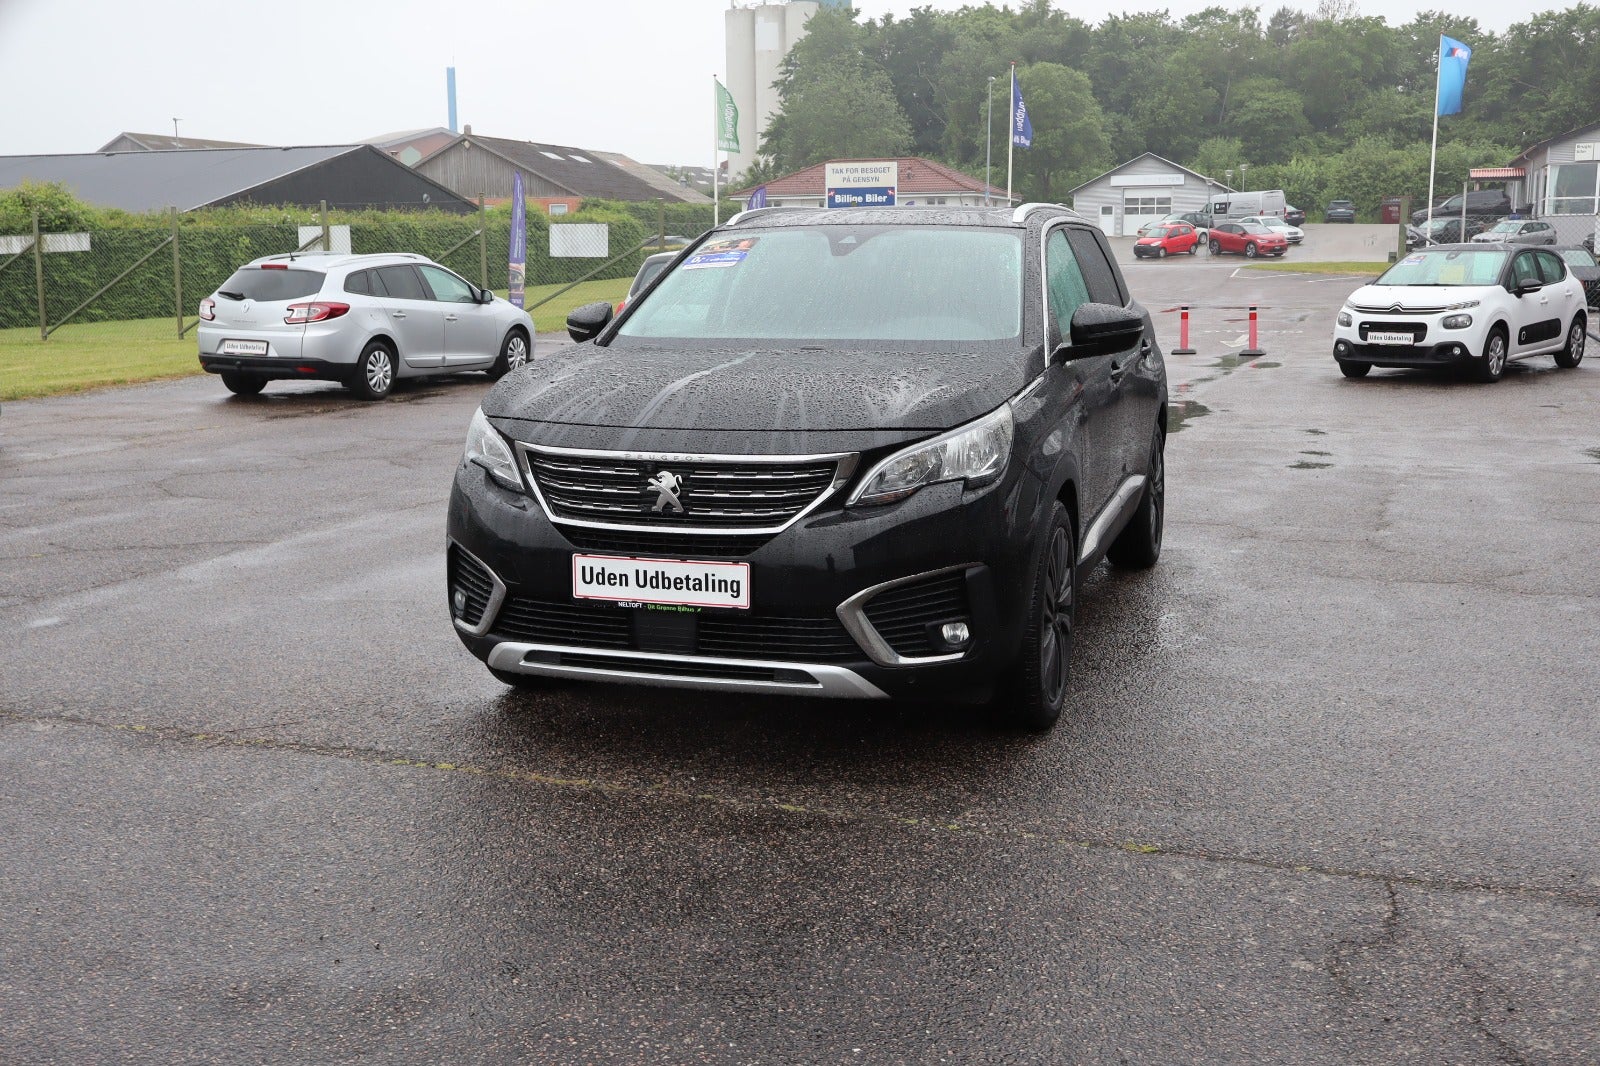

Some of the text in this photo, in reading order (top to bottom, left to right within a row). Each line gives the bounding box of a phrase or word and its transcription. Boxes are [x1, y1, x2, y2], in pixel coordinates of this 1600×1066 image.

[845, 167, 859, 175] FOR
[865, 193, 888, 203] Biler
[1383, 334, 1412, 343] Udbetaling
[623, 453, 705, 462] PEUGEOT
[581, 565, 741, 599] Uden Udbetaling
[618, 601, 643, 609] NELTOFT
